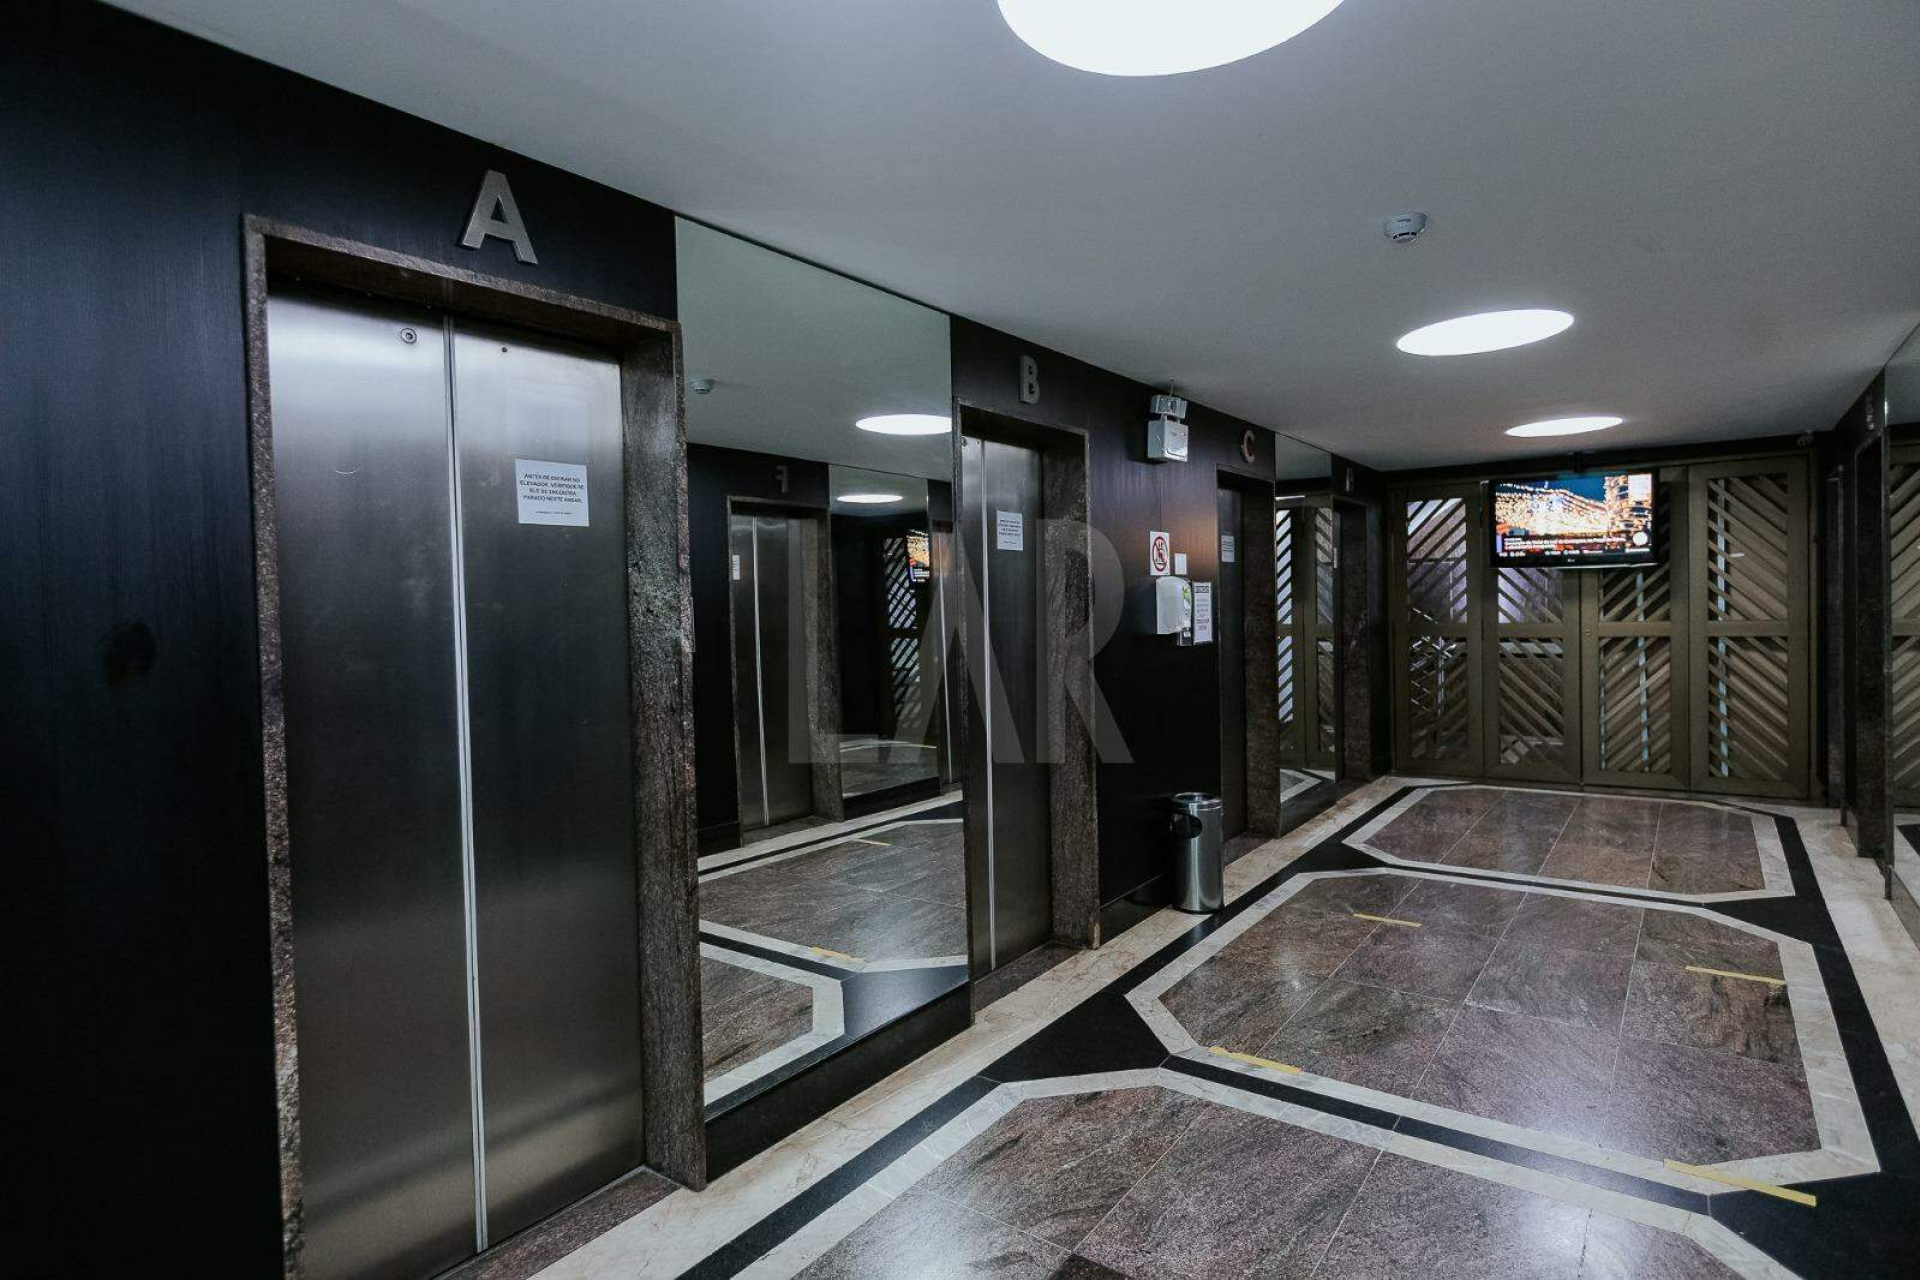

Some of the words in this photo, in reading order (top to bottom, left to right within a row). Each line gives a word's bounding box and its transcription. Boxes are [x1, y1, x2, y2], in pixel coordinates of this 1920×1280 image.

[461, 168, 538, 264] A
[1019, 354, 1040, 404] B
[1242, 430, 1256, 463] C
[524, 472, 542, 480] ANTES
